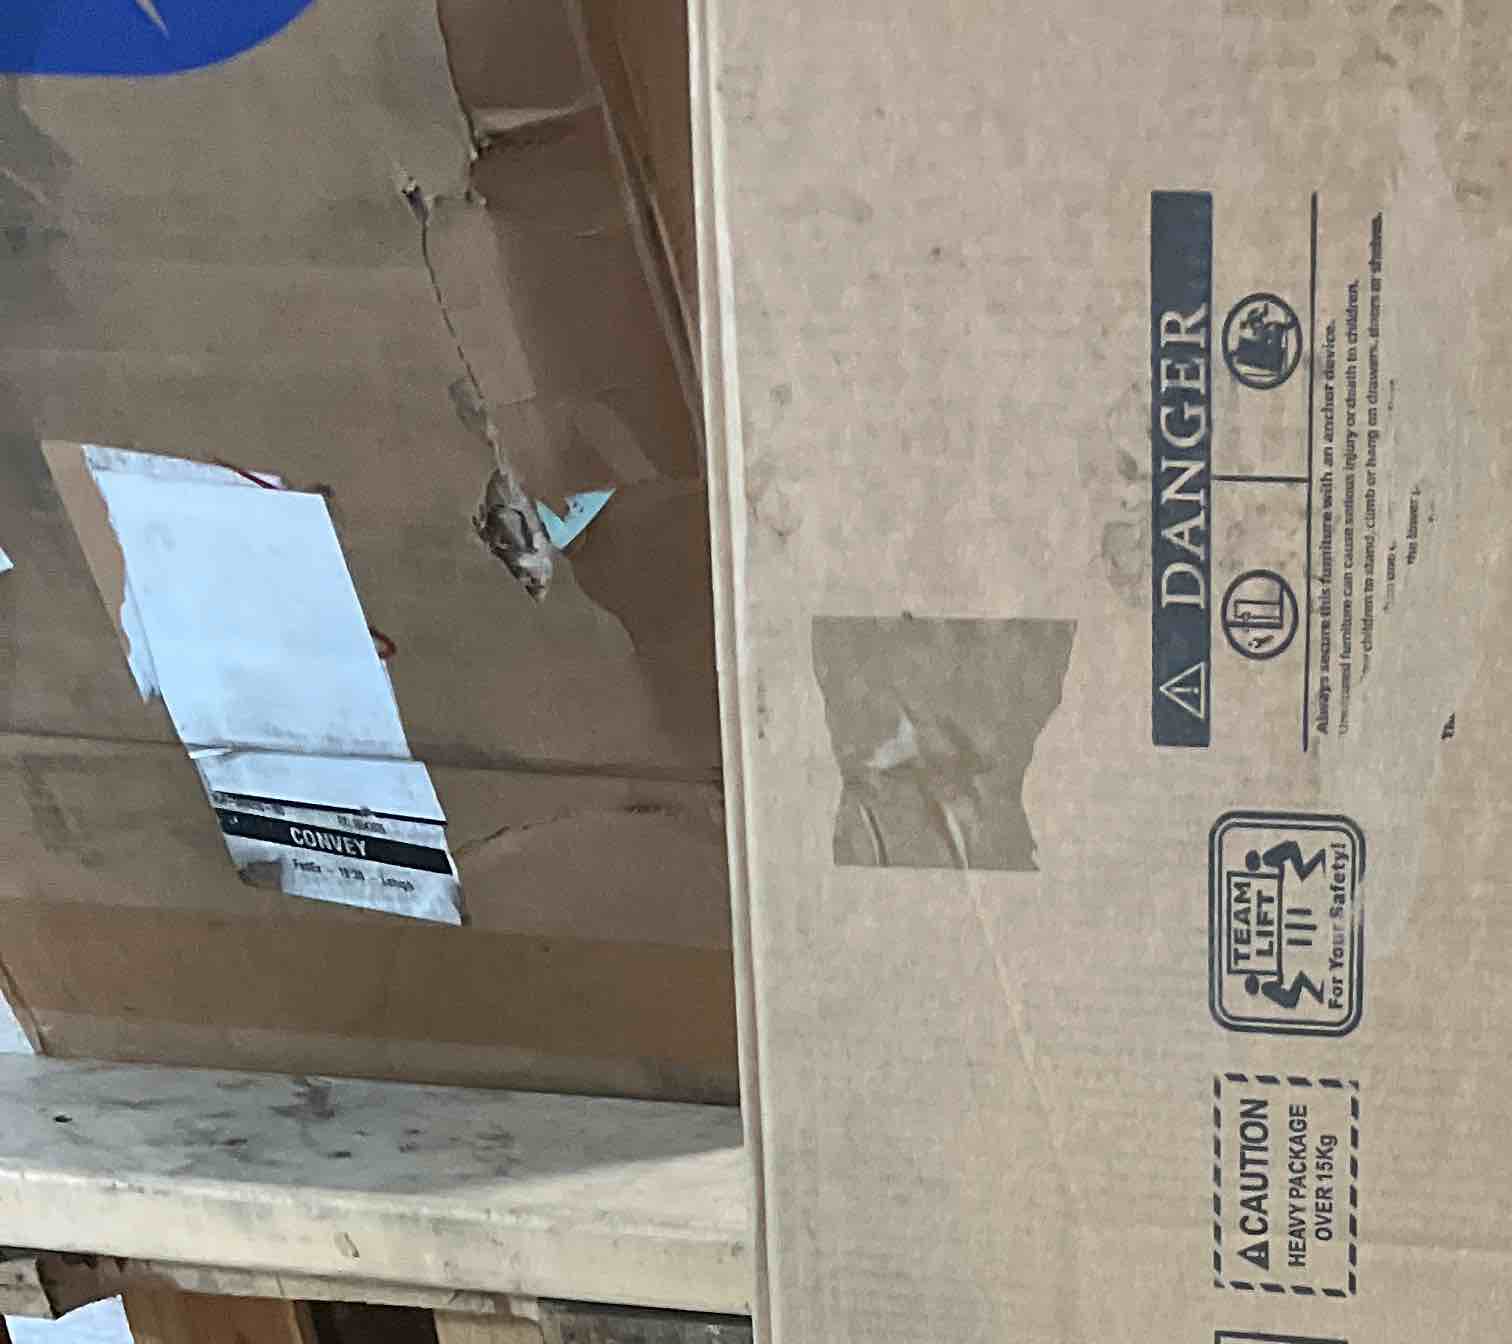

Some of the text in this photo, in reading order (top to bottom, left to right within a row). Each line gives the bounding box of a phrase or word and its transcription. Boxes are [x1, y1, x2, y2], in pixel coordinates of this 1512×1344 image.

[1345, 412, 1356, 427] or
[1160, 302, 1208, 609] DANGER
[1343, 429, 1358, 471] injury
[1365, 429, 1379, 468] hang
[1343, 474, 1354, 525] serious
[1366, 470, 1377, 487] or
[1316, 319, 1335, 735] Always secure this furniture with an anchor device.
[1364, 488, 1376, 528] climb
[1342, 527, 1354, 569] cause
[1342, 572, 1352, 597] can
[1338, 599, 1352, 660] furniture
[289, 825, 368, 857] CONVEY
[1233, 881, 1251, 966] TEAM
[1256, 889, 1275, 957] LIFT
[1328, 843, 1349, 1009] For Your Safety!
[1239, 1098, 1269, 1236] CAUTION
[1287, 1103, 1308, 1267] HEAVY PACKAGE
[1315, 1186, 1333, 1241] OVER
